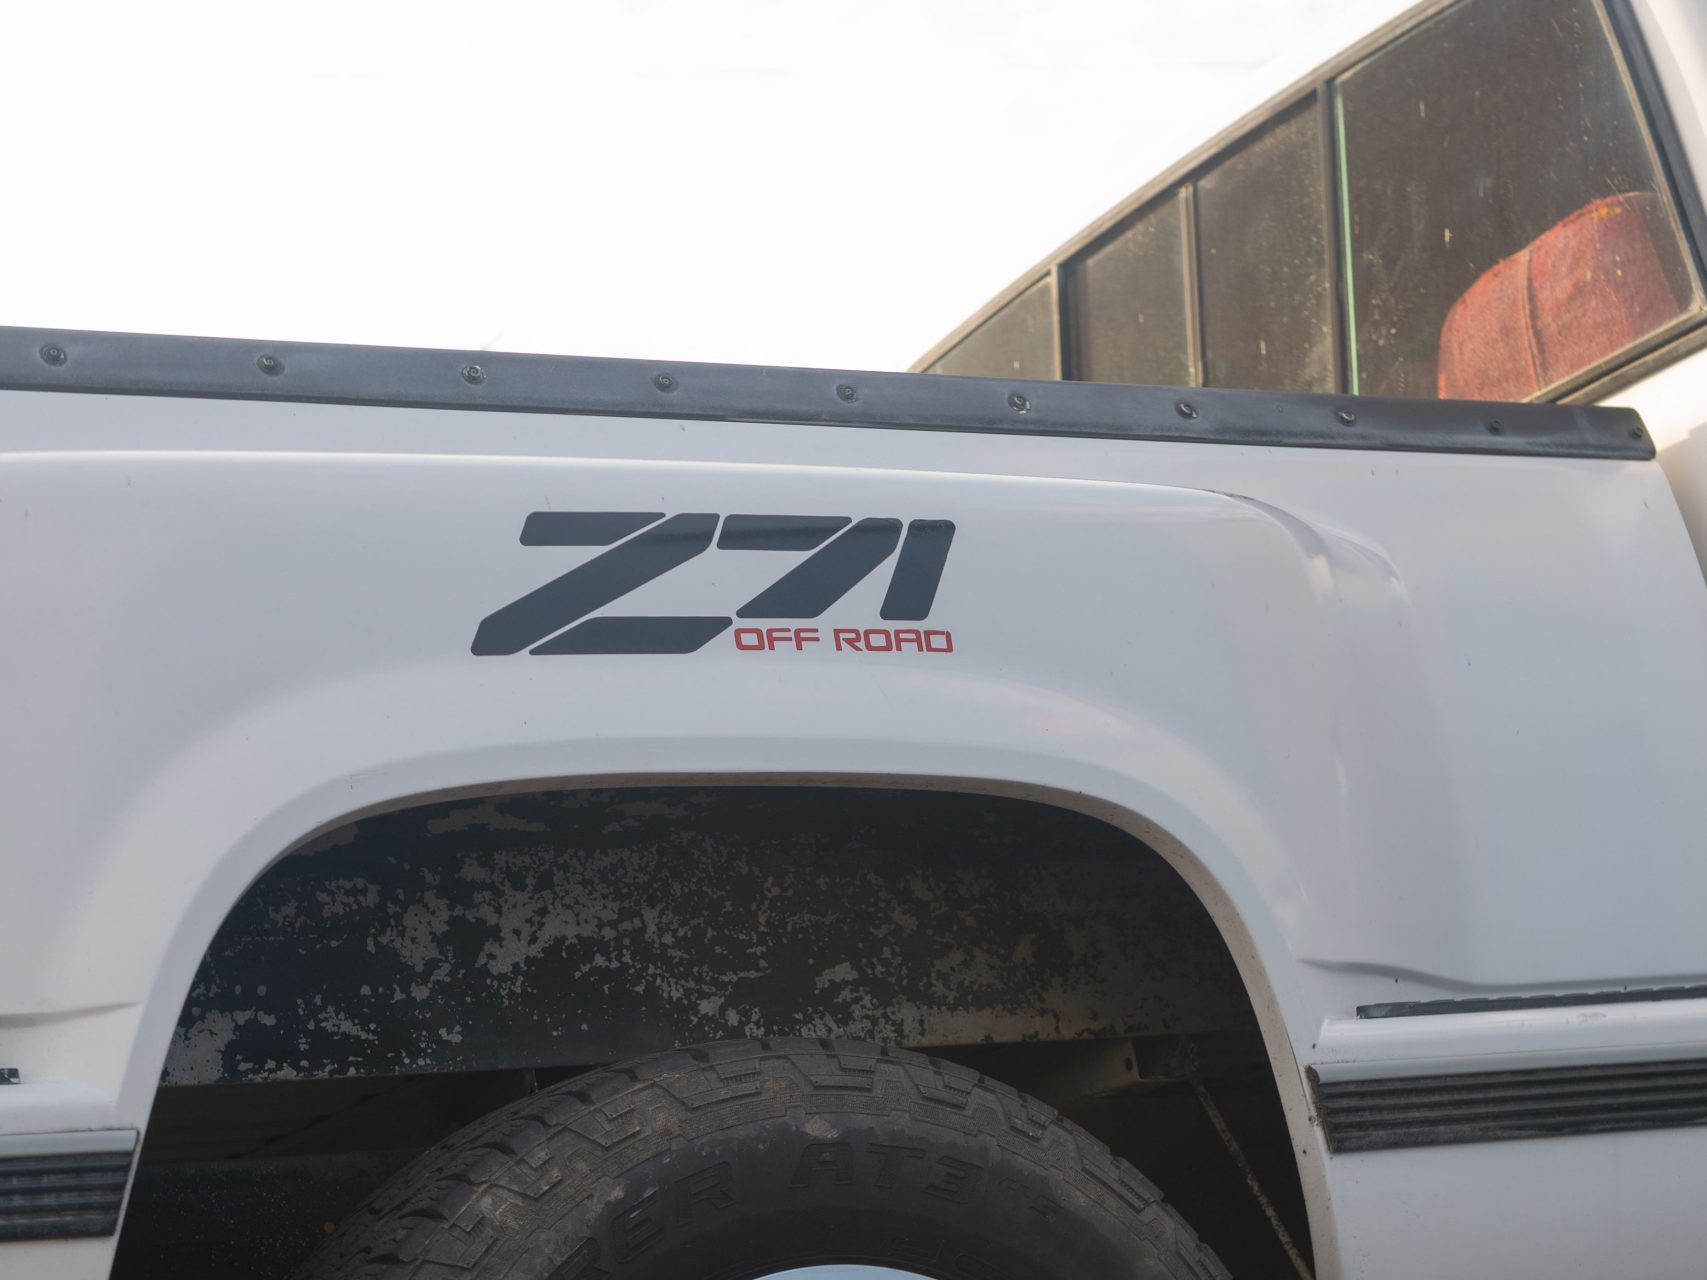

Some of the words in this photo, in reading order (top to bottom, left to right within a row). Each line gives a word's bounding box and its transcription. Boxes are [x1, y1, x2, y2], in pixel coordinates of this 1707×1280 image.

[470, 511, 956, 656] Z71
[734, 628, 820, 651] OFF
[833, 628, 953, 653] ROAD
[788, 1141, 984, 1205] AT3
